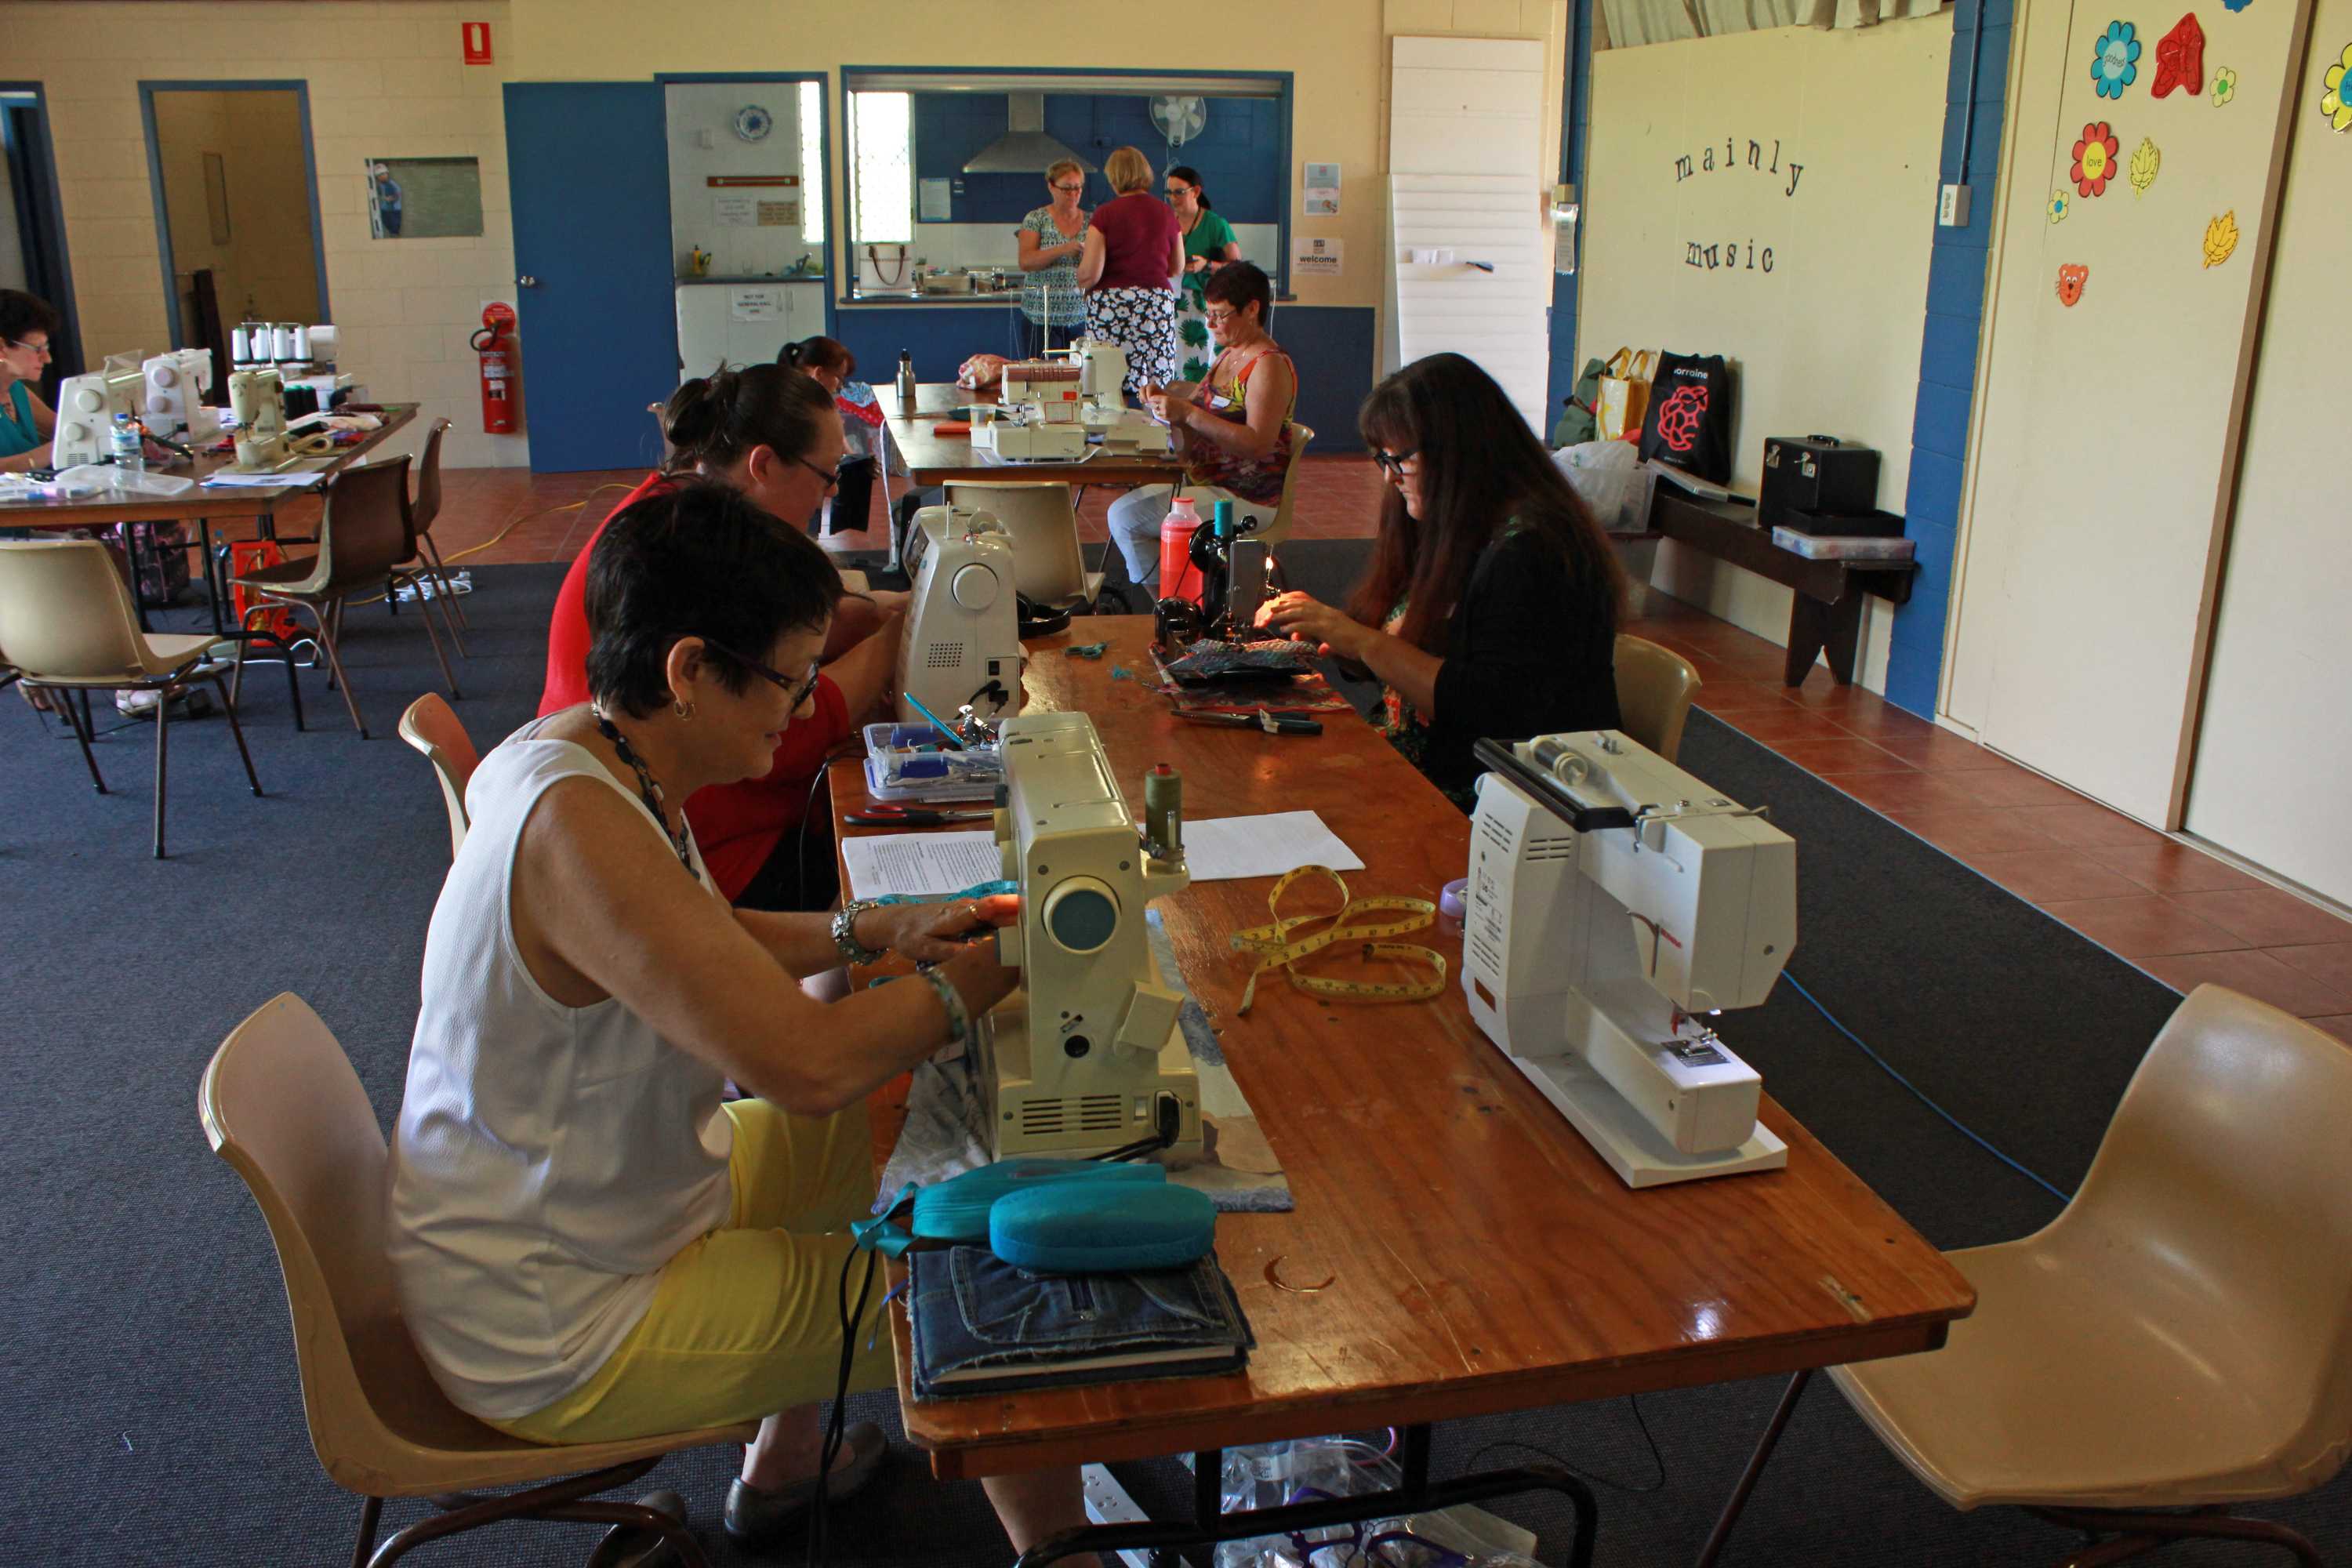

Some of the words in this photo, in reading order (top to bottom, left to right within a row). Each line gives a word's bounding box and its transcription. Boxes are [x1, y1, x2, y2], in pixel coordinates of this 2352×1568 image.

[1675, 137, 1803, 196] mainly
[2086, 154, 2102, 167] love
[1299, 255, 1337, 263] welcome
[1686, 238, 1773, 273] music
